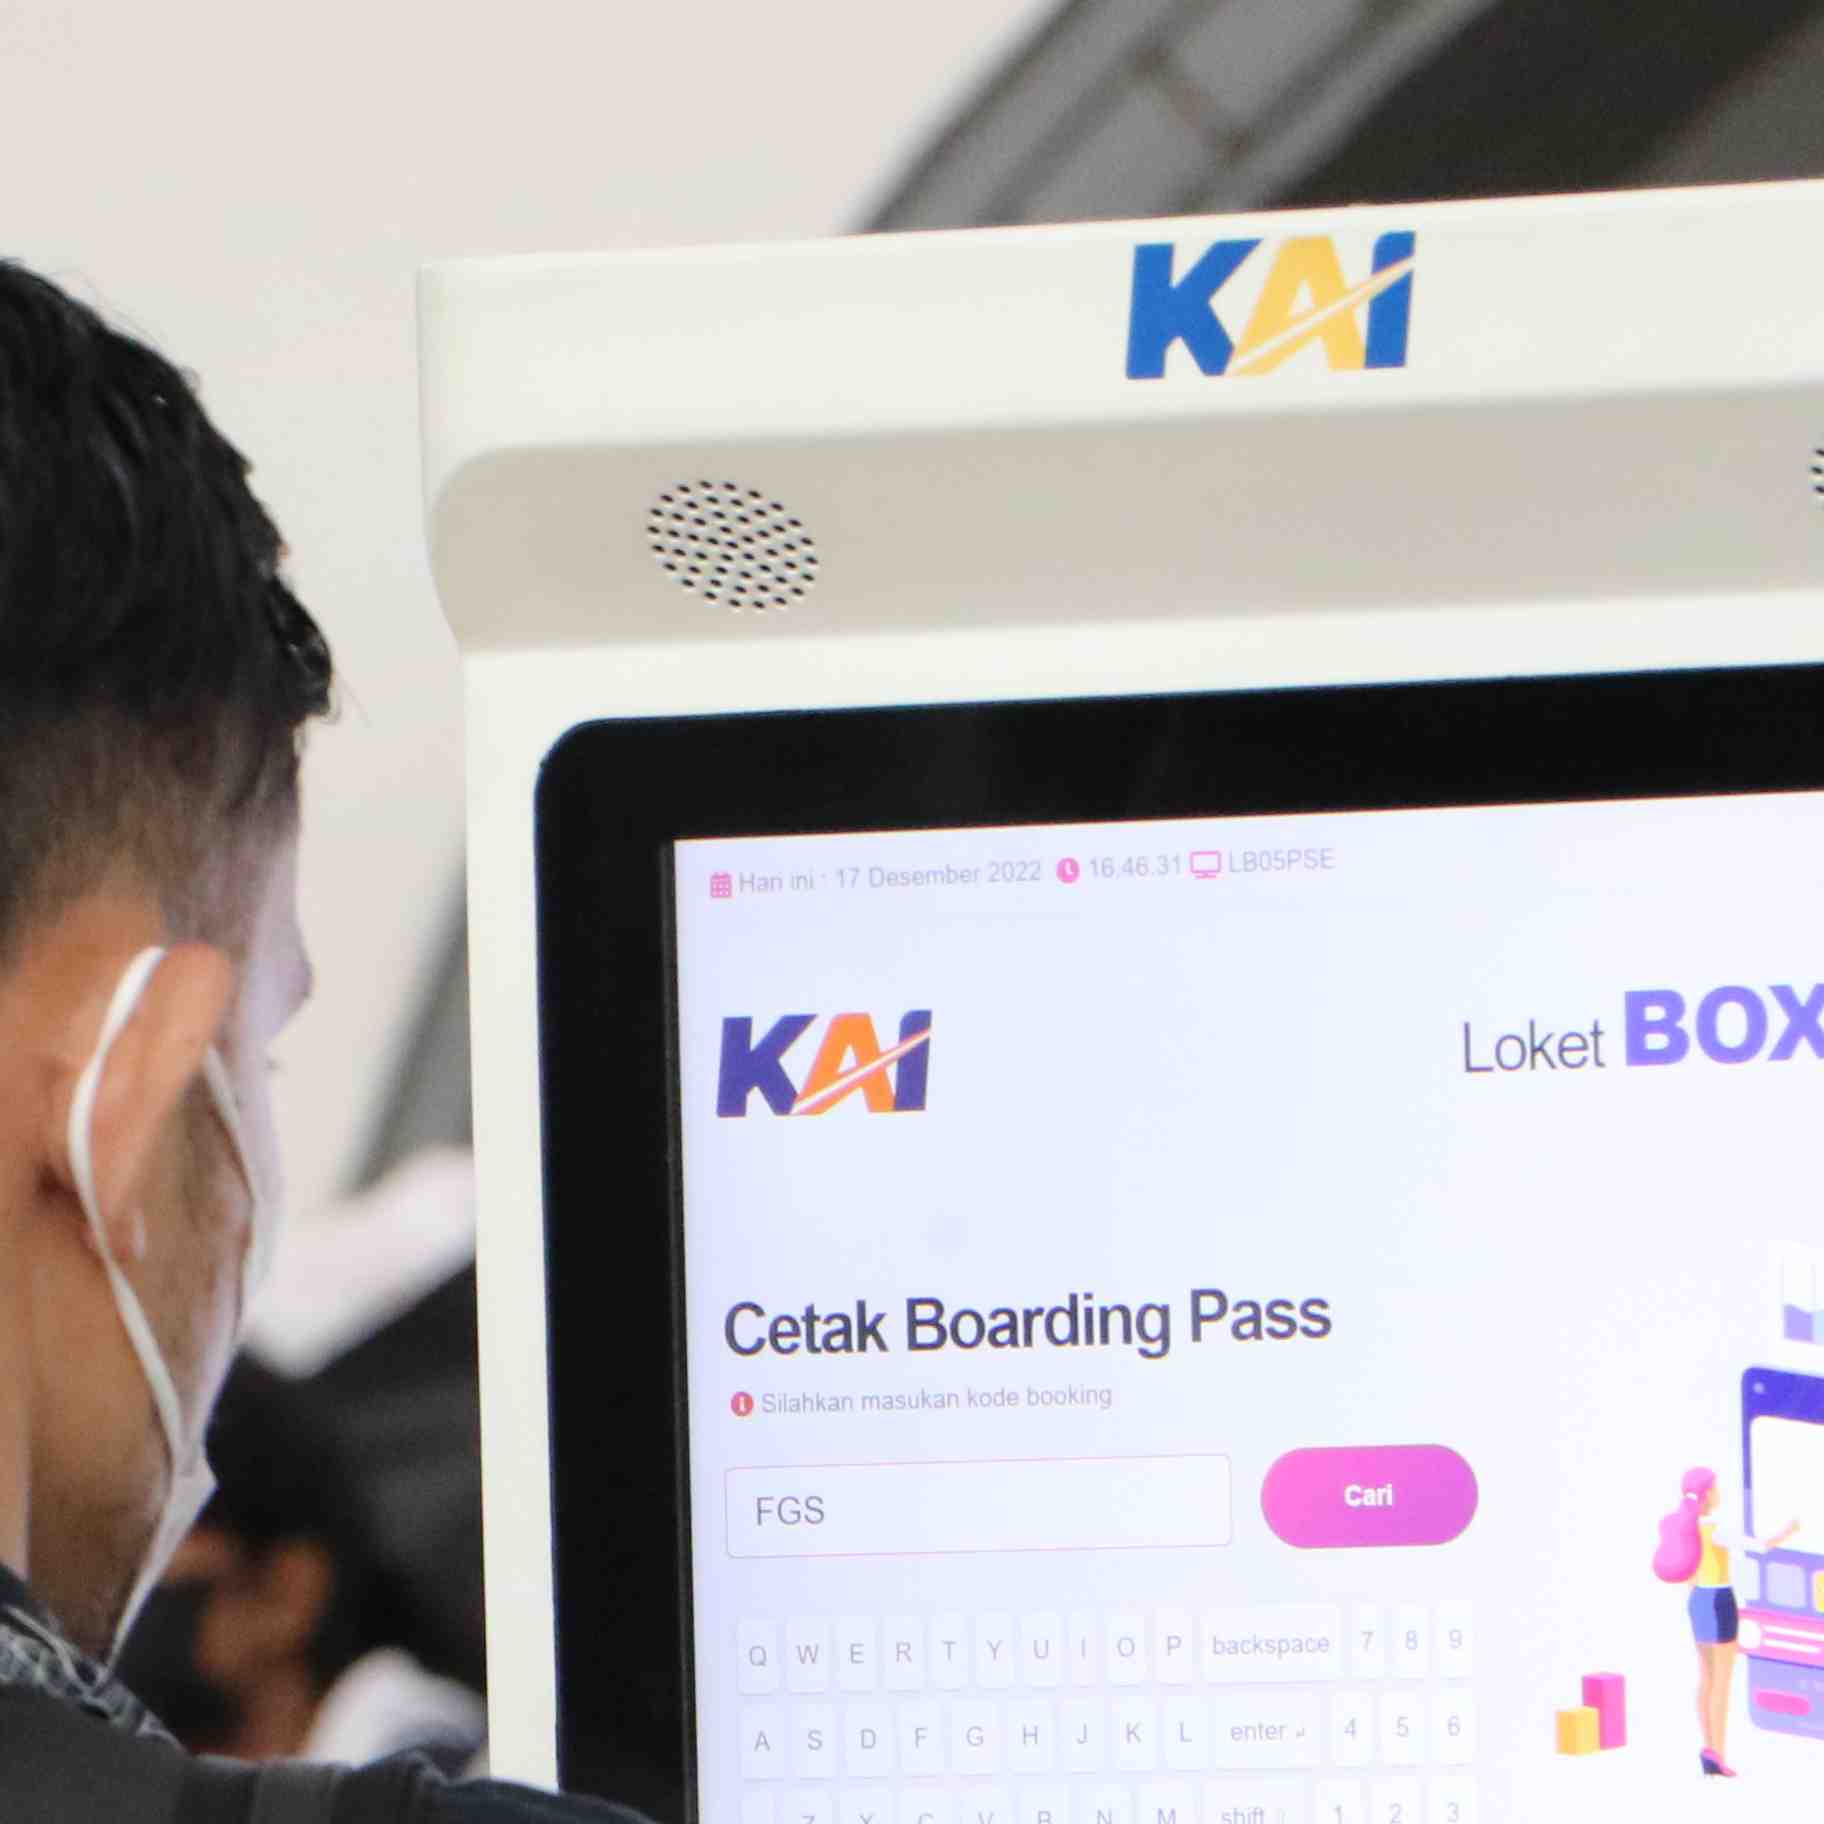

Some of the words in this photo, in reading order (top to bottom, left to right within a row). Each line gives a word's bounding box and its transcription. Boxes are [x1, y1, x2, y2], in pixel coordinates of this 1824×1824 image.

[1126, 230, 1416, 379] KAI
[739, 870, 784, 893] Hari
[790, 870, 814, 891] ini
[837, 867, 859, 888] 17
[868, 862, 979, 888] Desember
[988, 859, 1040, 882] 2022
[717, 1009, 932, 1118] KAI
[1464, 1020, 1604, 1072] Loket
[725, 1299, 888, 1355] Cetak
[906, 1294, 1169, 1359] Boarding
[1190, 1289, 1331, 1341] Pass
[762, 1390, 853, 1413] Silahkan
[861, 1388, 959, 1410] masukan
[967, 1386, 1018, 1408] kode
[1026, 1384, 1111, 1411] booking
[755, 1496, 824, 1526] FGS
[1344, 1483, 1392, 1505] Cari
[749, 1644, 766, 1668] Q
[797, 1644, 818, 1664] W
[850, 1643, 864, 1662] E
[896, 1642, 911, 1661] R
[942, 1641, 956, 1660] T
[986, 1640, 1001, 1660] Y
[1034, 1639, 1048, 1658] U
[1116, 1636, 1135, 1656] O
[1166, 1636, 1181, 1655] P
[1212, 1632, 1329, 1659] backspace
[1360, 1632, 1372, 1651] 7
[1405, 1631, 1417, 1651] 8
[1449, 1631, 1461, 1649] 9
[753, 1730, 770, 1751] A
[807, 1730, 821, 1750] S
[861, 1728, 875, 1748] D
[914, 1728, 927, 1747] F
[966, 1726, 983, 1746] G
[1022, 1726, 1037, 1745] H
[1076, 1724, 1087, 1744] J
[1126, 1722, 1141, 1742] K
[1179, 1722, 1191, 1742] L
[1230, 1721, 1286, 1741] enter
[1344, 1718, 1356, 1738] 4
[1396, 1716, 1408, 1736] 5
[1447, 1716, 1460, 1735] 6
[1389, 1804, 1401, 1824] 2
[1446, 1803, 1458, 1822] 3
